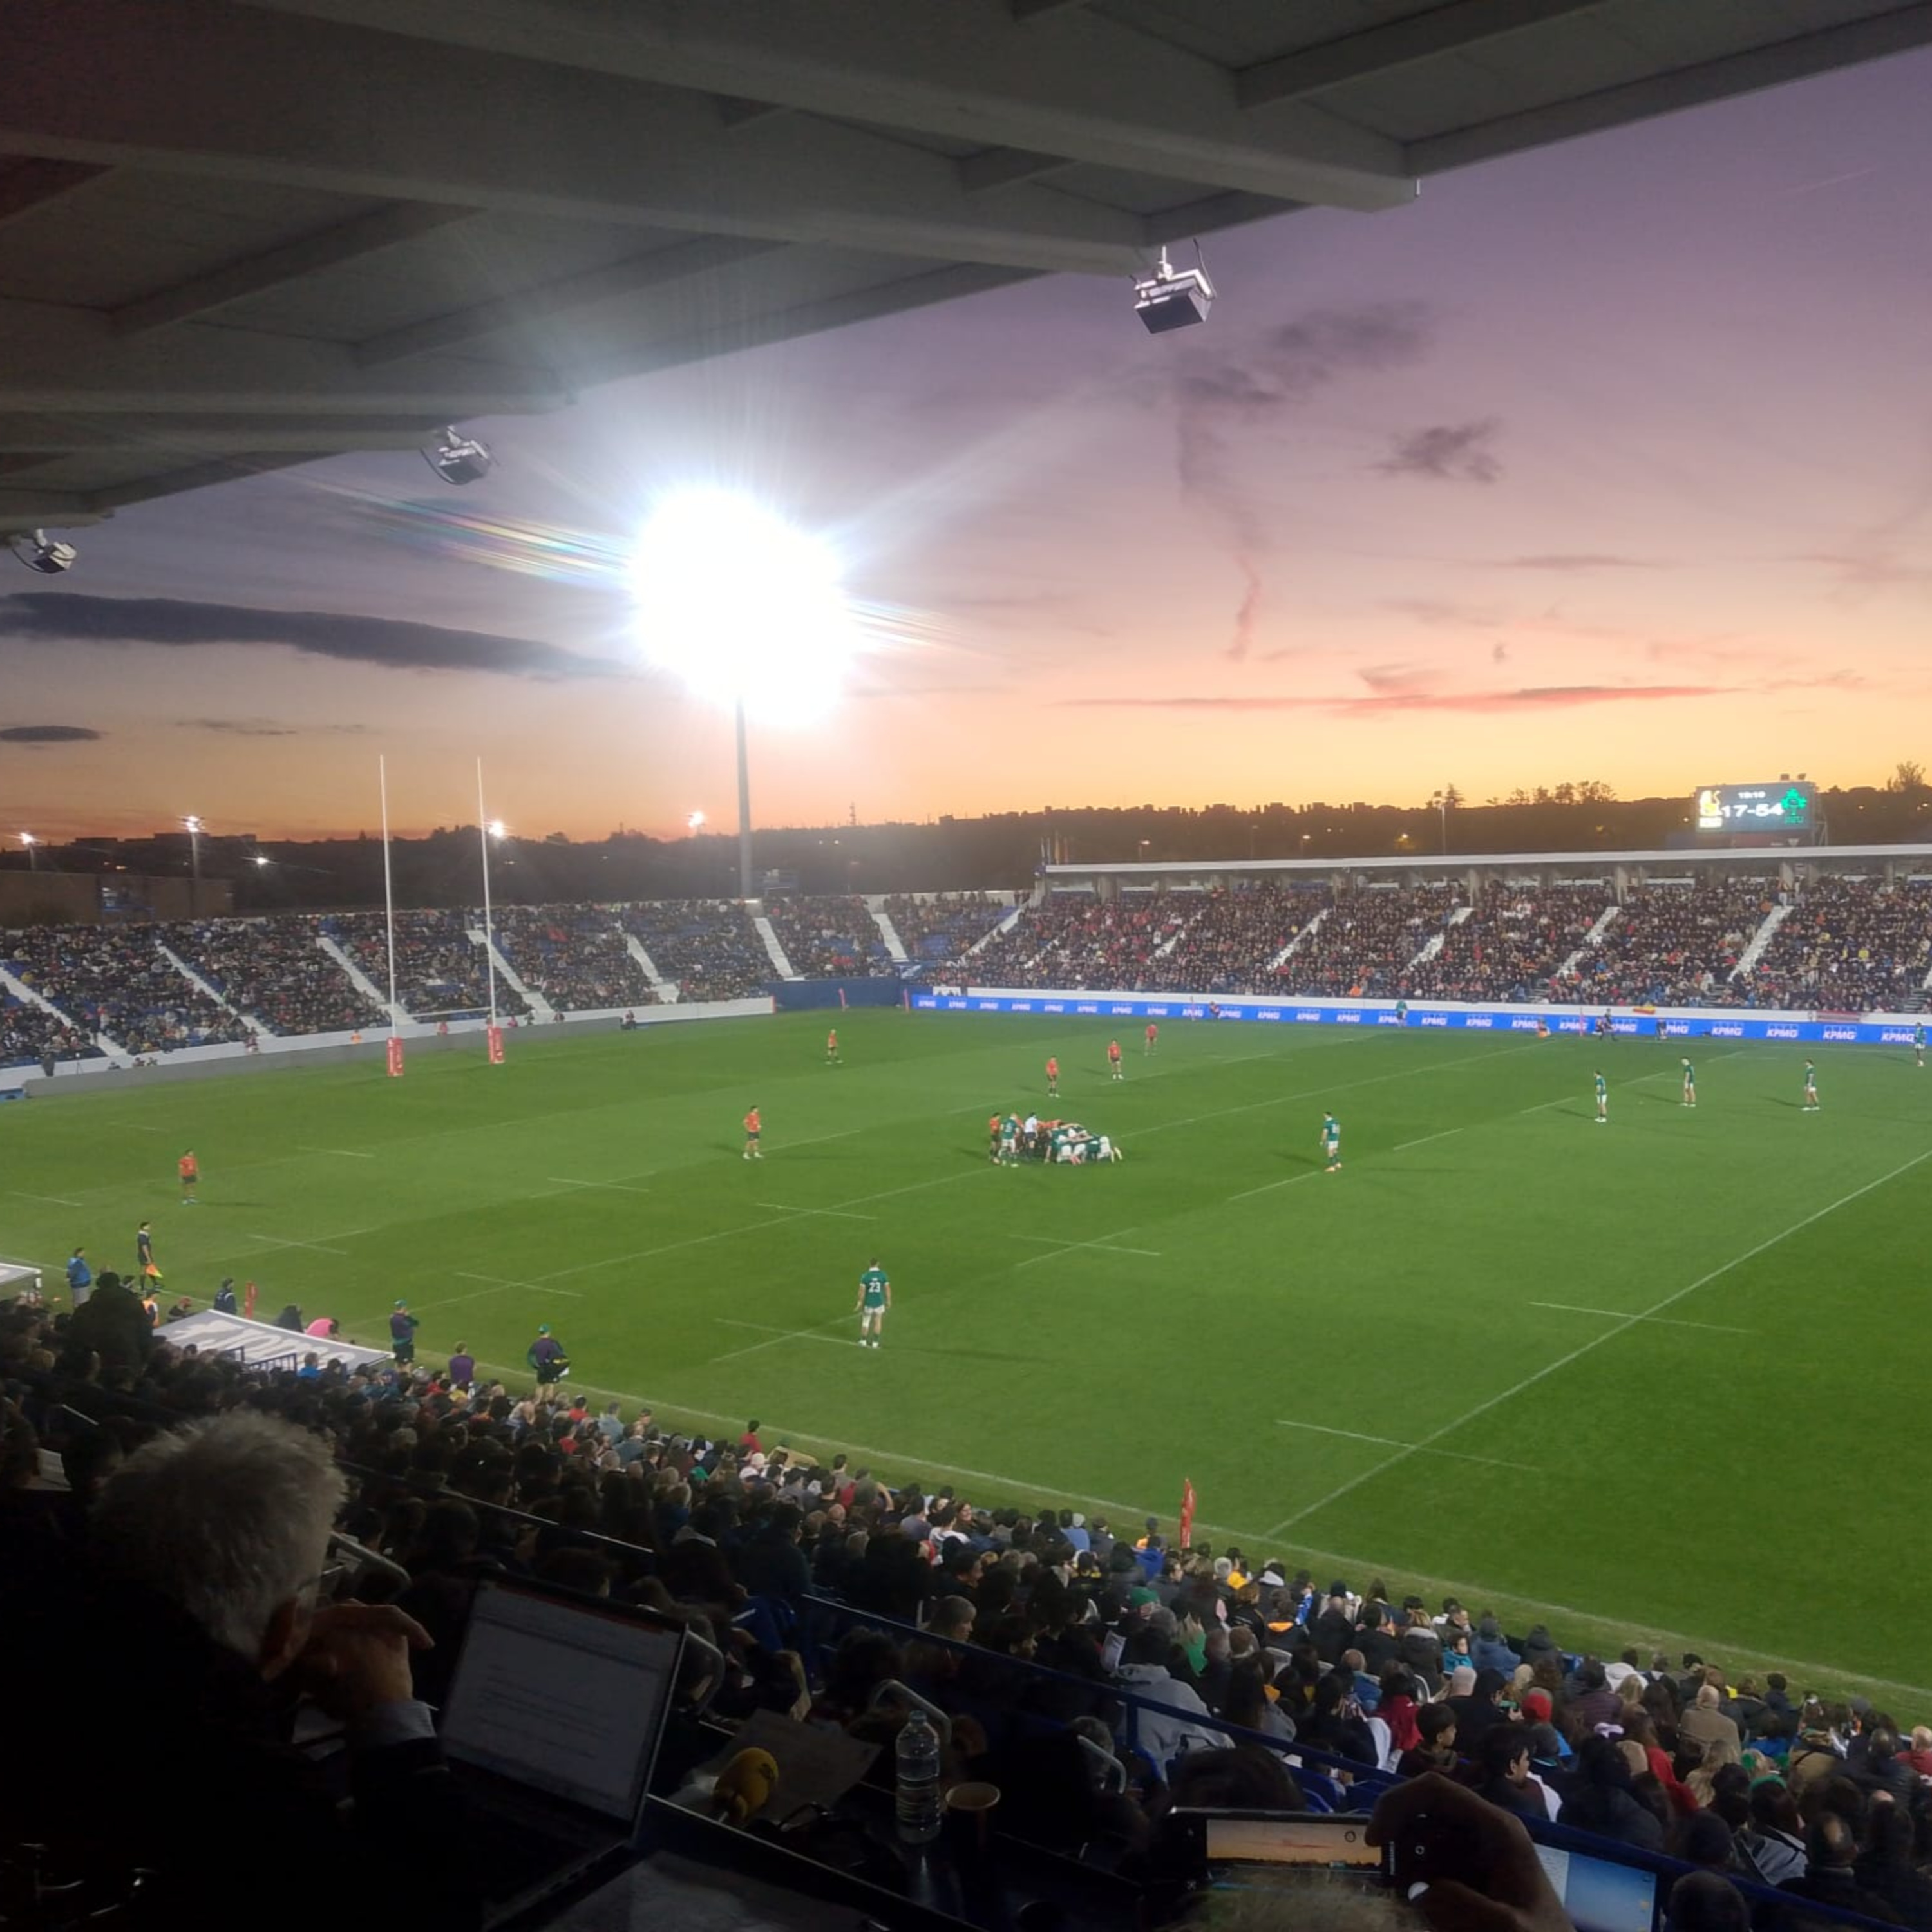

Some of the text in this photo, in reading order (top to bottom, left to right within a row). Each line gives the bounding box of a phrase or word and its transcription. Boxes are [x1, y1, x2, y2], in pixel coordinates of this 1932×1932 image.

[1422, 1018, 1446, 1026] KPMG
[1666, 1025, 1689, 1034] PMG
[1712, 1027, 1742, 1036] KPMG
[1766, 1028, 1797, 1038] KPMG
[1823, 1030, 1855, 1040] KPMG
[1882, 1032, 1916, 1043] KPMG
[868, 1282, 881, 1293] 23
